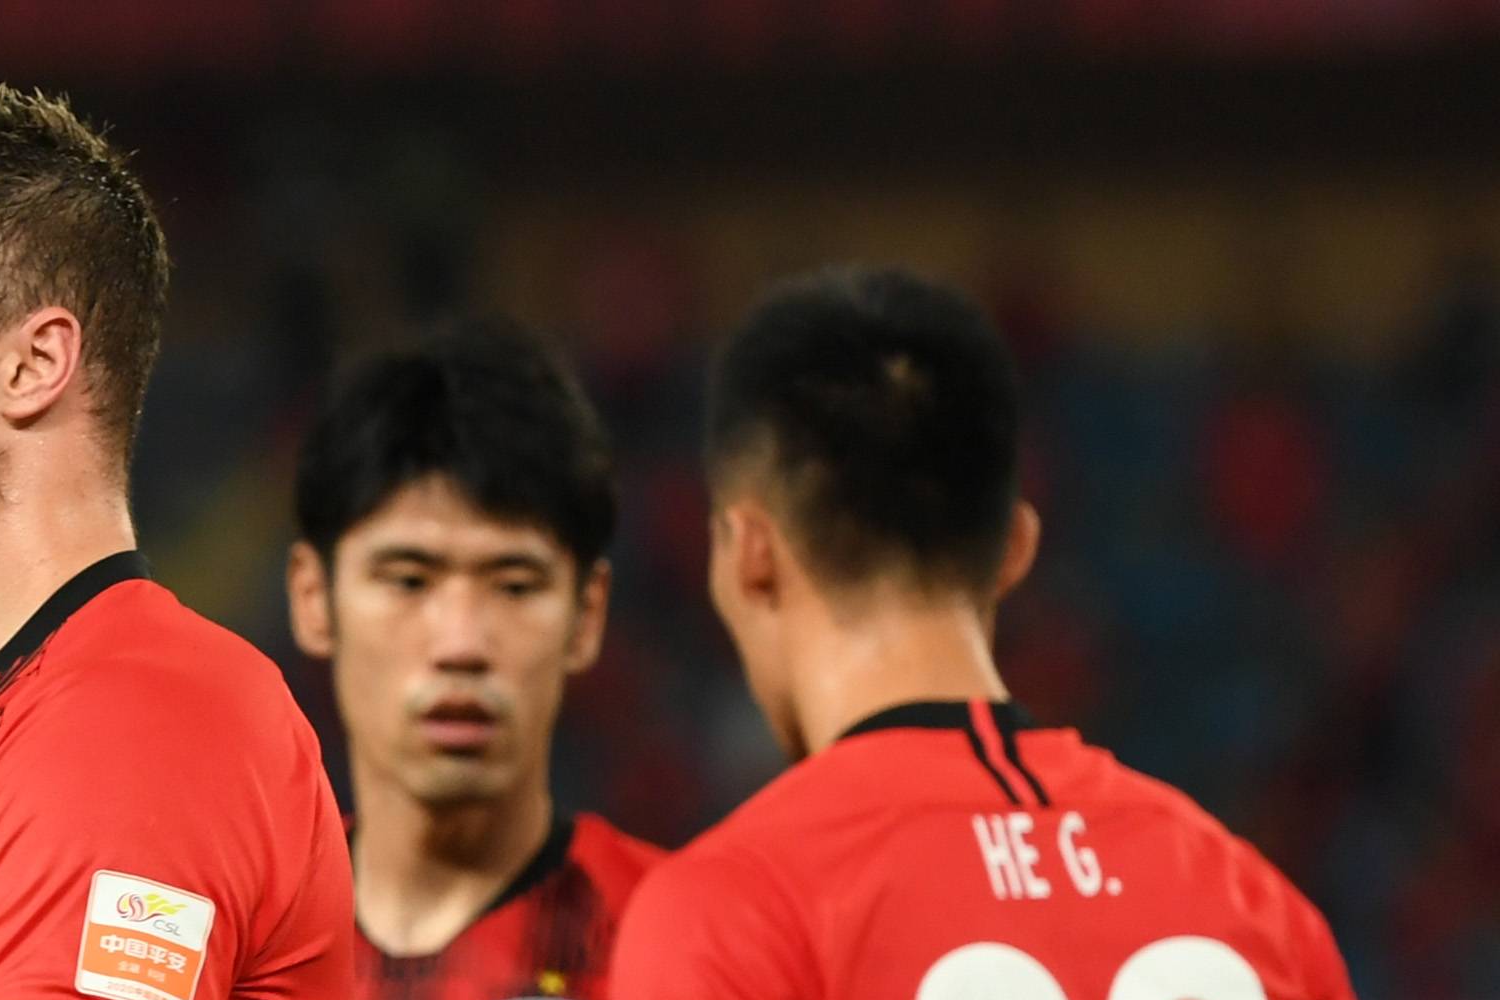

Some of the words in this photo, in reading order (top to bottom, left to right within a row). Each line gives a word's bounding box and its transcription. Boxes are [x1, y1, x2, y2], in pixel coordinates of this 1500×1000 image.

[971, 812, 1052, 900] HE
[1057, 811, 1123, 898] G.
[152, 918, 182, 937] CSL
[99, 934, 188, 975] 中国平安
